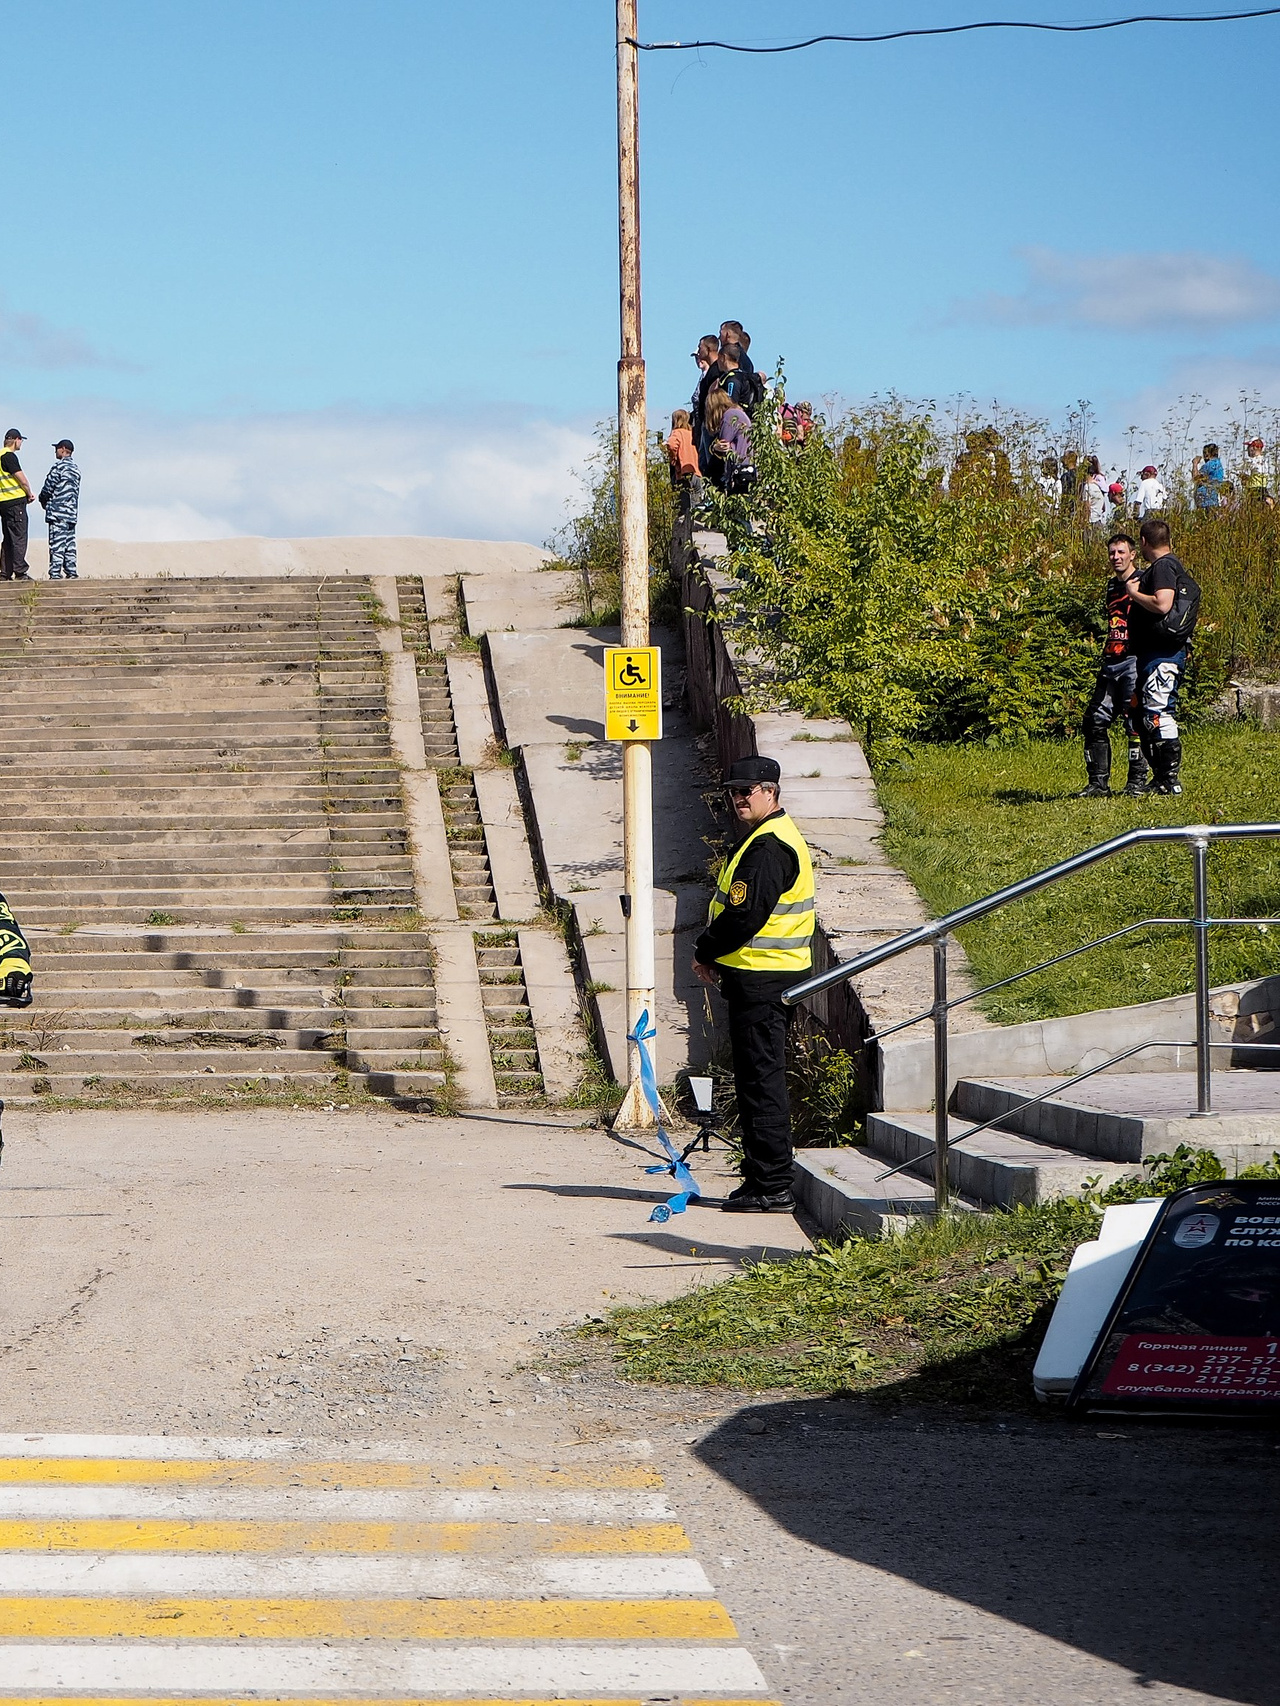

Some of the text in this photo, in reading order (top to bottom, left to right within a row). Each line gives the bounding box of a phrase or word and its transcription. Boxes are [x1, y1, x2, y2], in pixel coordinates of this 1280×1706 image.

[1224, 1239, 1280, 1247] ПО КО
[1137, 1341, 1197, 1351] Горячая
[1127, 1363, 1140, 1372] 8
[1143, 1364, 1195, 1375] (342)
